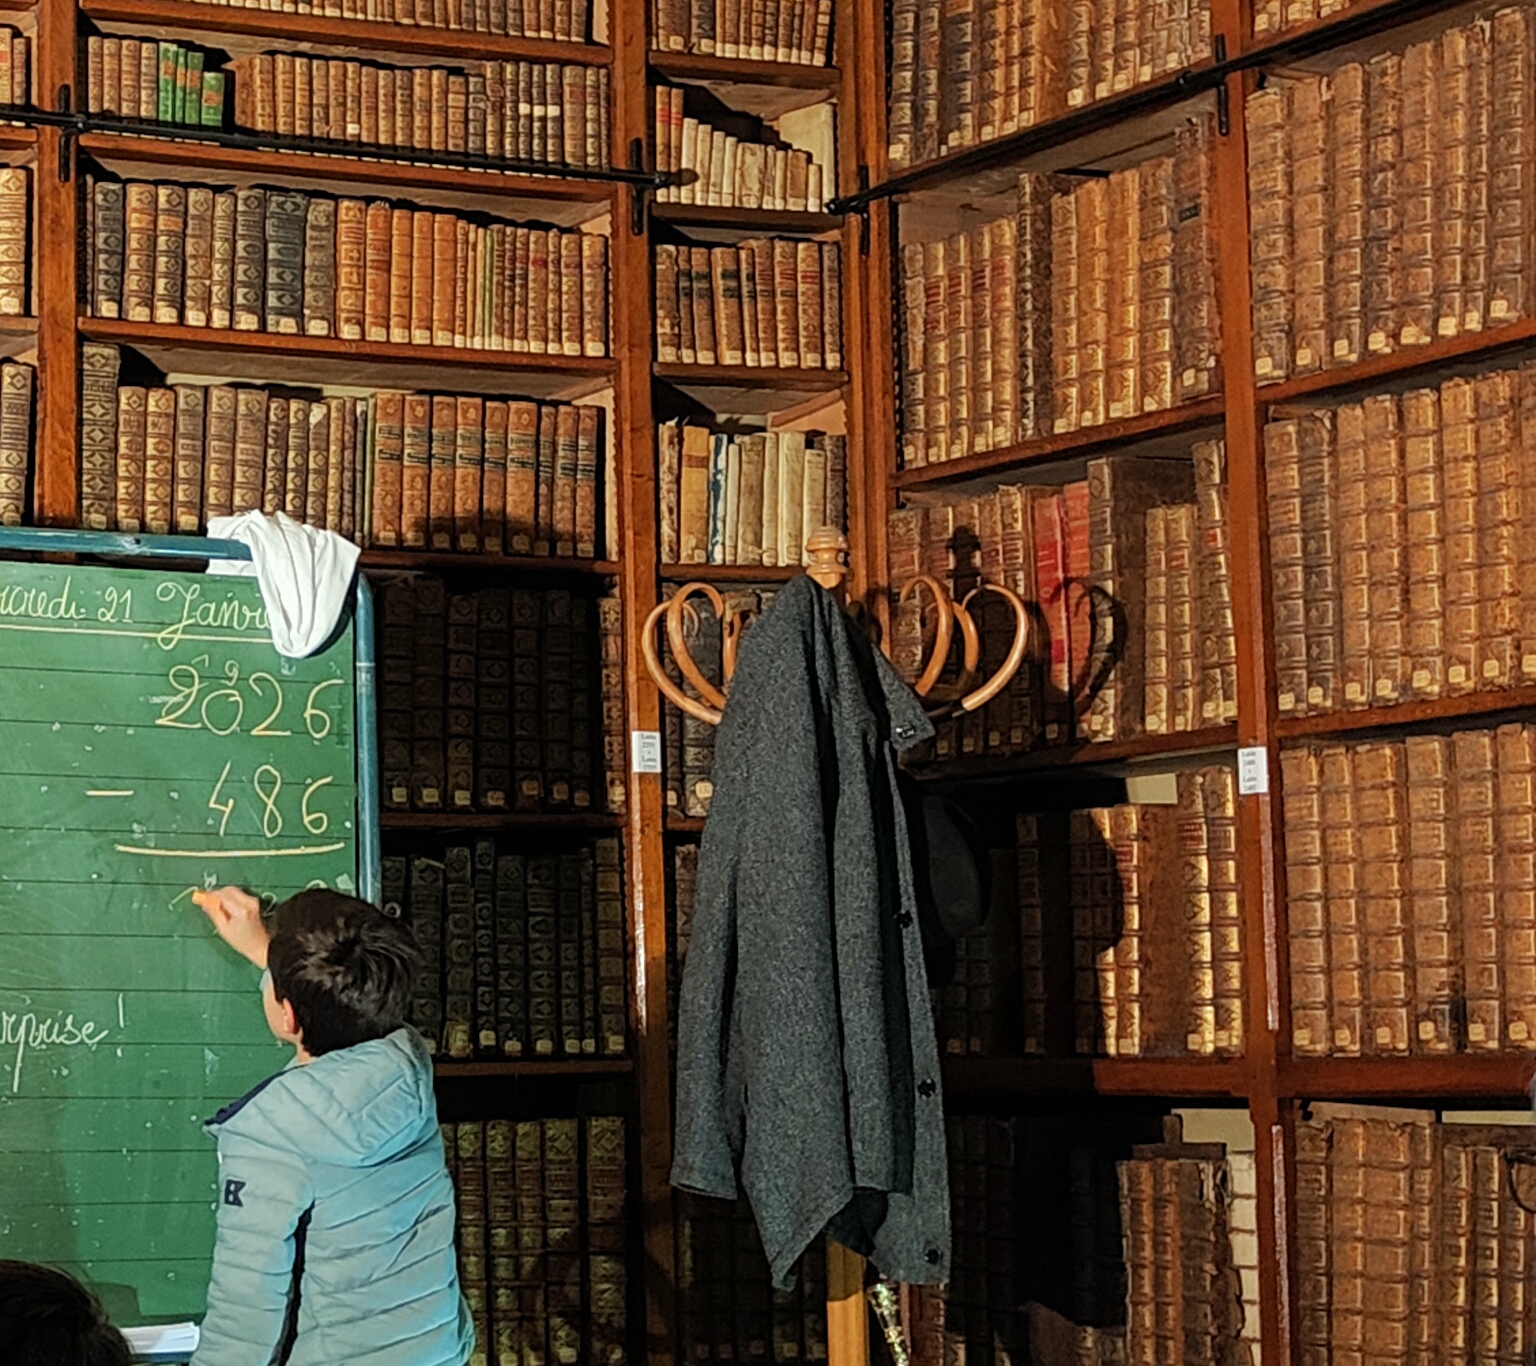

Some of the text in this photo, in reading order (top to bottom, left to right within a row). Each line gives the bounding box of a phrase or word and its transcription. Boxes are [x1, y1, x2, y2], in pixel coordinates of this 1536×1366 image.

[97, 586, 134, 623] 21
[155, 581, 269, 650] Janvi
[155, 663, 344, 739] 2026
[208, 760, 334, 837] 486
